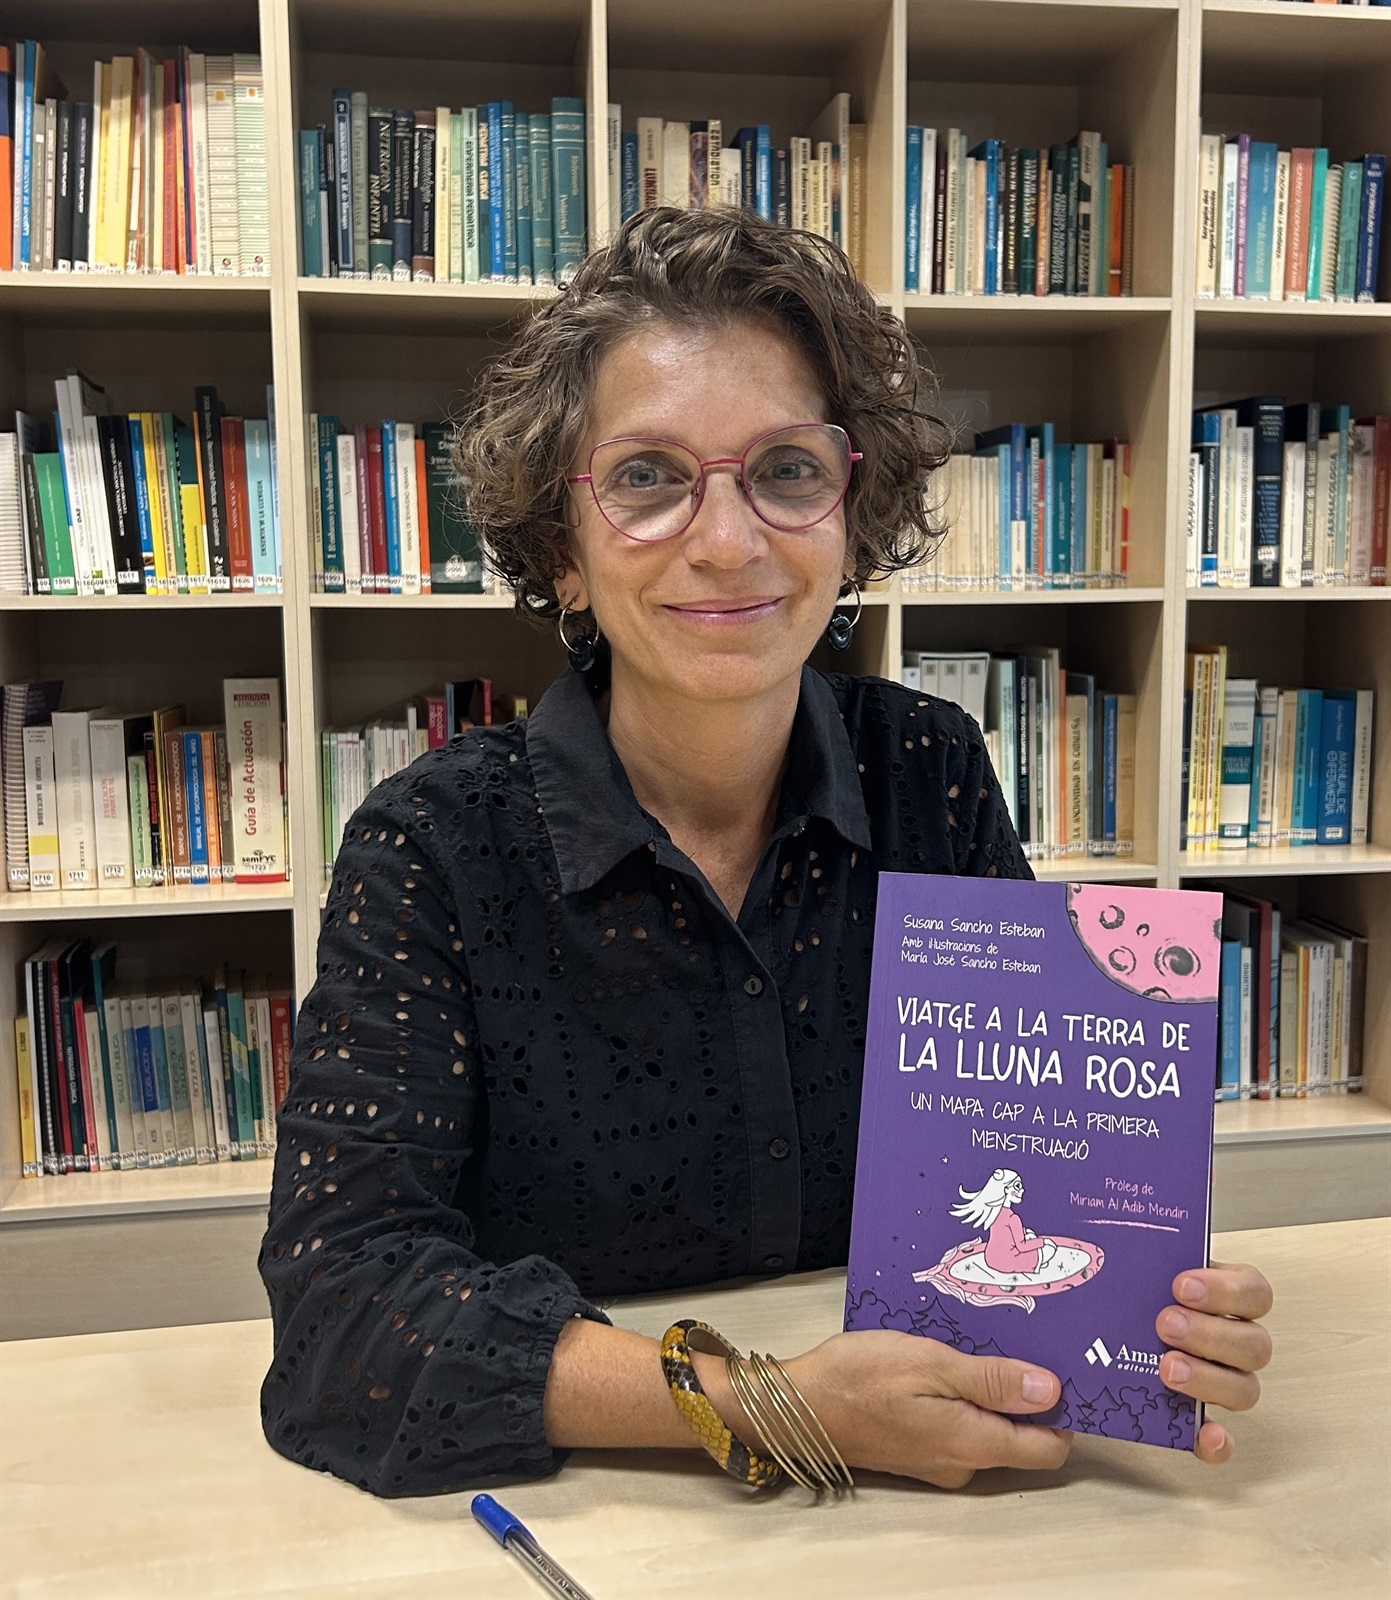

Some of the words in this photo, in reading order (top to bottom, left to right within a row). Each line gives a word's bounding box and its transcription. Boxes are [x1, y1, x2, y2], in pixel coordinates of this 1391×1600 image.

[241, 720, 254, 782] Actuación
[243, 788, 255, 803] de
[244, 808, 257, 836] Guía
[903, 913, 944, 931] Susana
[951, 917, 993, 935] Sancho
[999, 921, 1045, 939] Esteban
[901, 935, 923, 949] Amb
[986, 942, 999, 955] de
[901, 950, 928, 965] María
[933, 952, 956, 967] José
[961, 955, 997, 970] Sancho
[1002, 958, 1041, 974] Esteban
[897, 996, 976, 1034] VIATGE
[985, 1006, 1002, 1032] A
[1017, 1007, 1048, 1037] LA
[1062, 1014, 1145, 1046] TERRA
[1162, 1021, 1190, 1052] DE
[898, 1032, 938, 1072] LA
[956, 1039, 1063, 1087] LLUNA
[1085, 1054, 1180, 1100] ROSA
[910, 1091, 932, 1112] UN
[940, 1094, 984, 1119] MAPA
[992, 1100, 1025, 1123] CAP
[1032, 1105, 1045, 1125] A
[1053, 1107, 1078, 1129] LA
[1087, 1112, 1160, 1140] PRIMERA
[971, 1128, 1090, 1161] MENSTRUACIÓ
[1105, 1177, 1139, 1197] Pròleg
[1141, 1182, 1154, 1196] de
[1069, 1192, 1105, 1209] Miriam
[1108, 1197, 1119, 1211] Al
[1121, 1198, 1145, 1214] Adib
[1148, 1202, 1189, 1220] Mendiri
[1118, 1363, 1159, 1375] editoria
